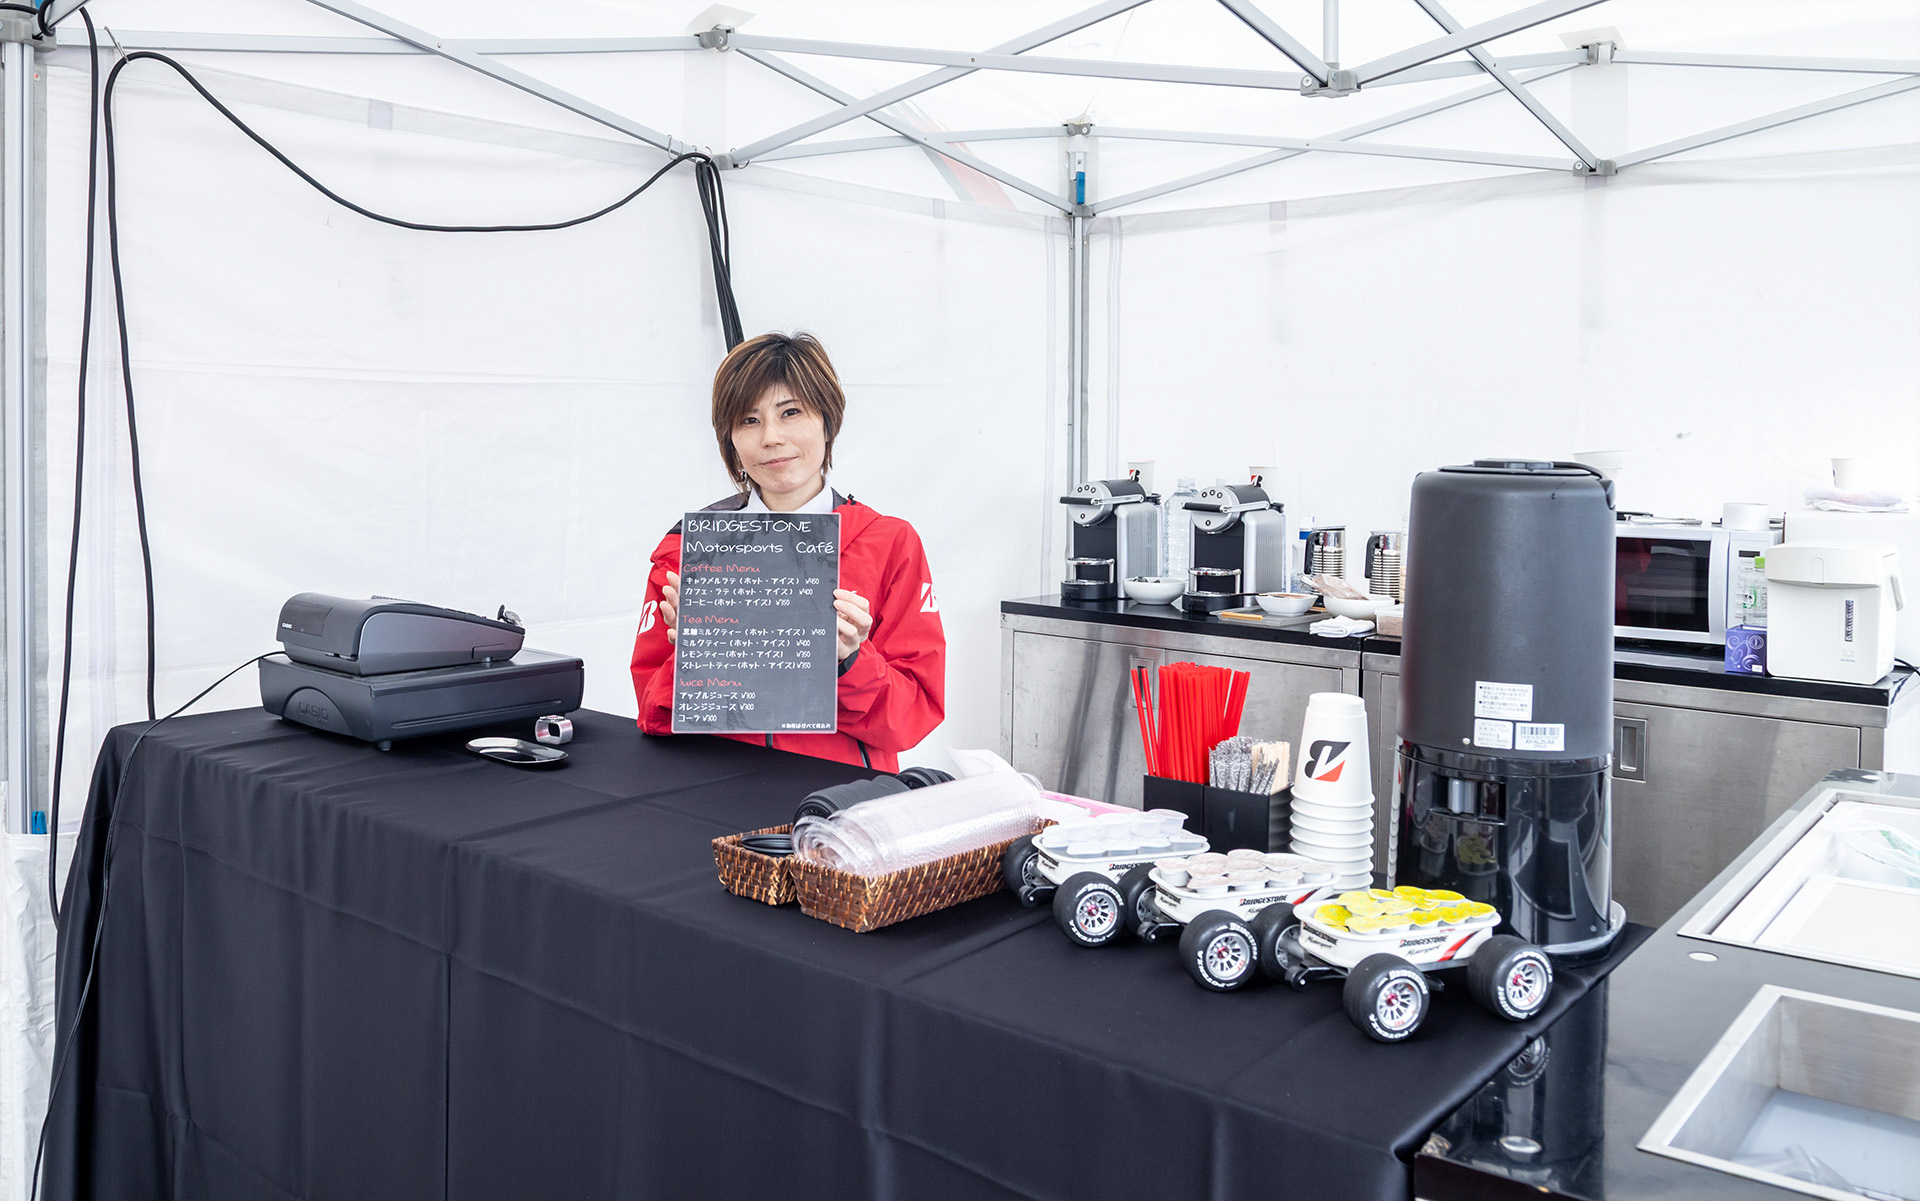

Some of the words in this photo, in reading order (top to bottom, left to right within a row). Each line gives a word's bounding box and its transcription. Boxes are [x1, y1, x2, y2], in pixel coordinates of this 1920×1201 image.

[687, 519, 811, 533] BRIDGESTONE
[686, 540, 783, 554] Motorsports
[795, 541, 834, 554] Café
[683, 563, 723, 573] Coffee
[726, 563, 760, 573] Menu
[681, 615, 702, 624] Tea
[705, 615, 739, 624] Menu
[678, 677, 704, 687] Juice
[707, 677, 742, 687] Menu
[297, 702, 329, 720] CASIO
[678, 702, 737, 712] オレンジジュース
[678, 714, 700, 723] コーラ
[1239, 894, 1288, 907] BRIDGESTONE
[1398, 935, 1449, 948] BRIDGESTONE
